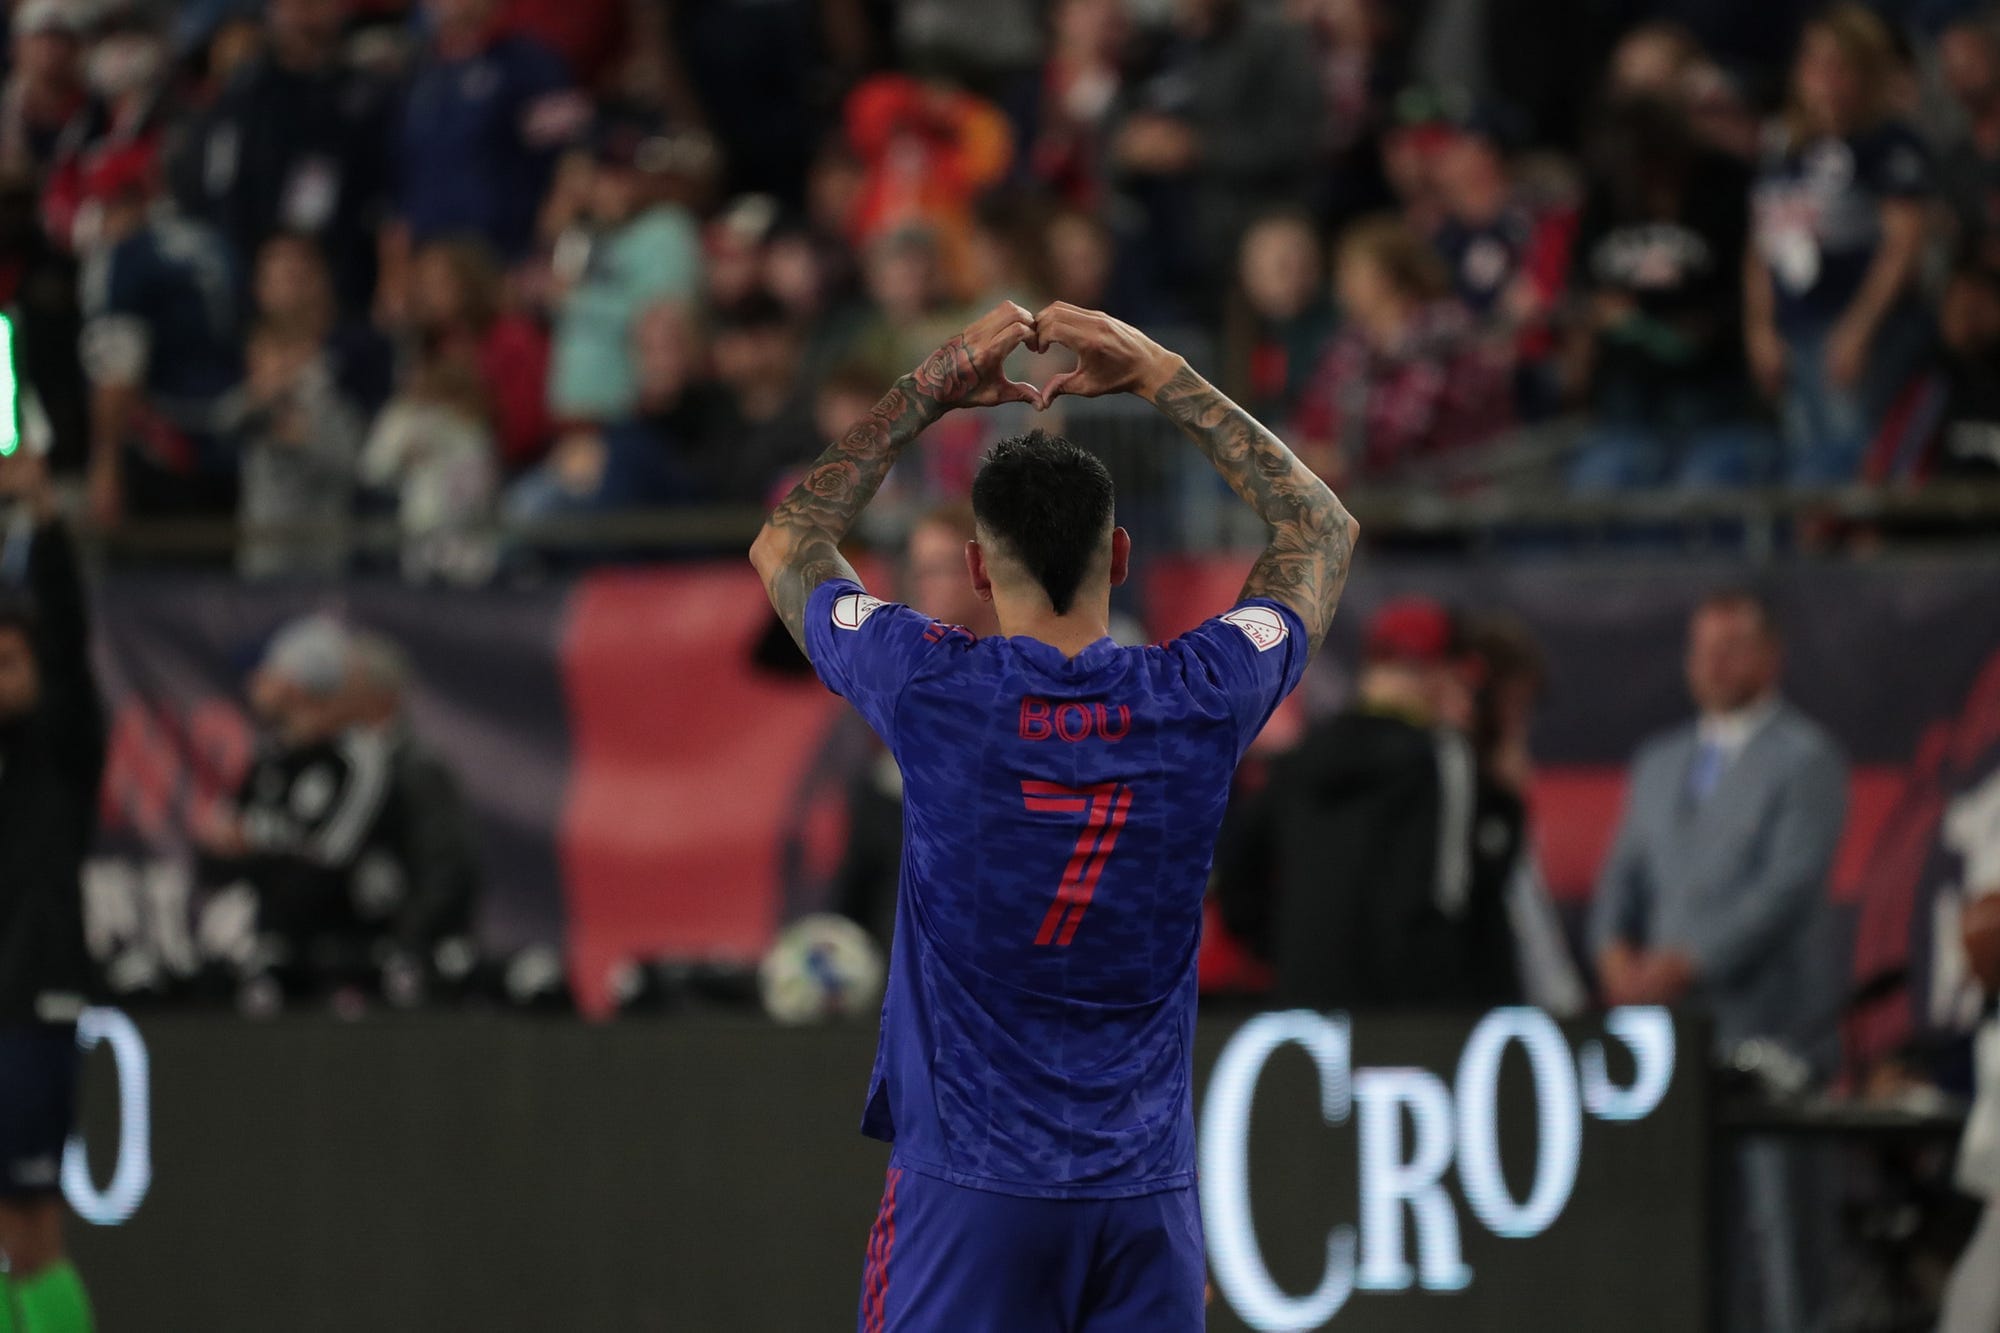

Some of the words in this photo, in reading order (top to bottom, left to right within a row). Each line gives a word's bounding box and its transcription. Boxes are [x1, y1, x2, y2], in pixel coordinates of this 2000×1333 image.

[1243, 622, 1266, 644] MLS
[1018, 696, 1131, 743] BOU
[1020, 780, 1135, 945] 7
